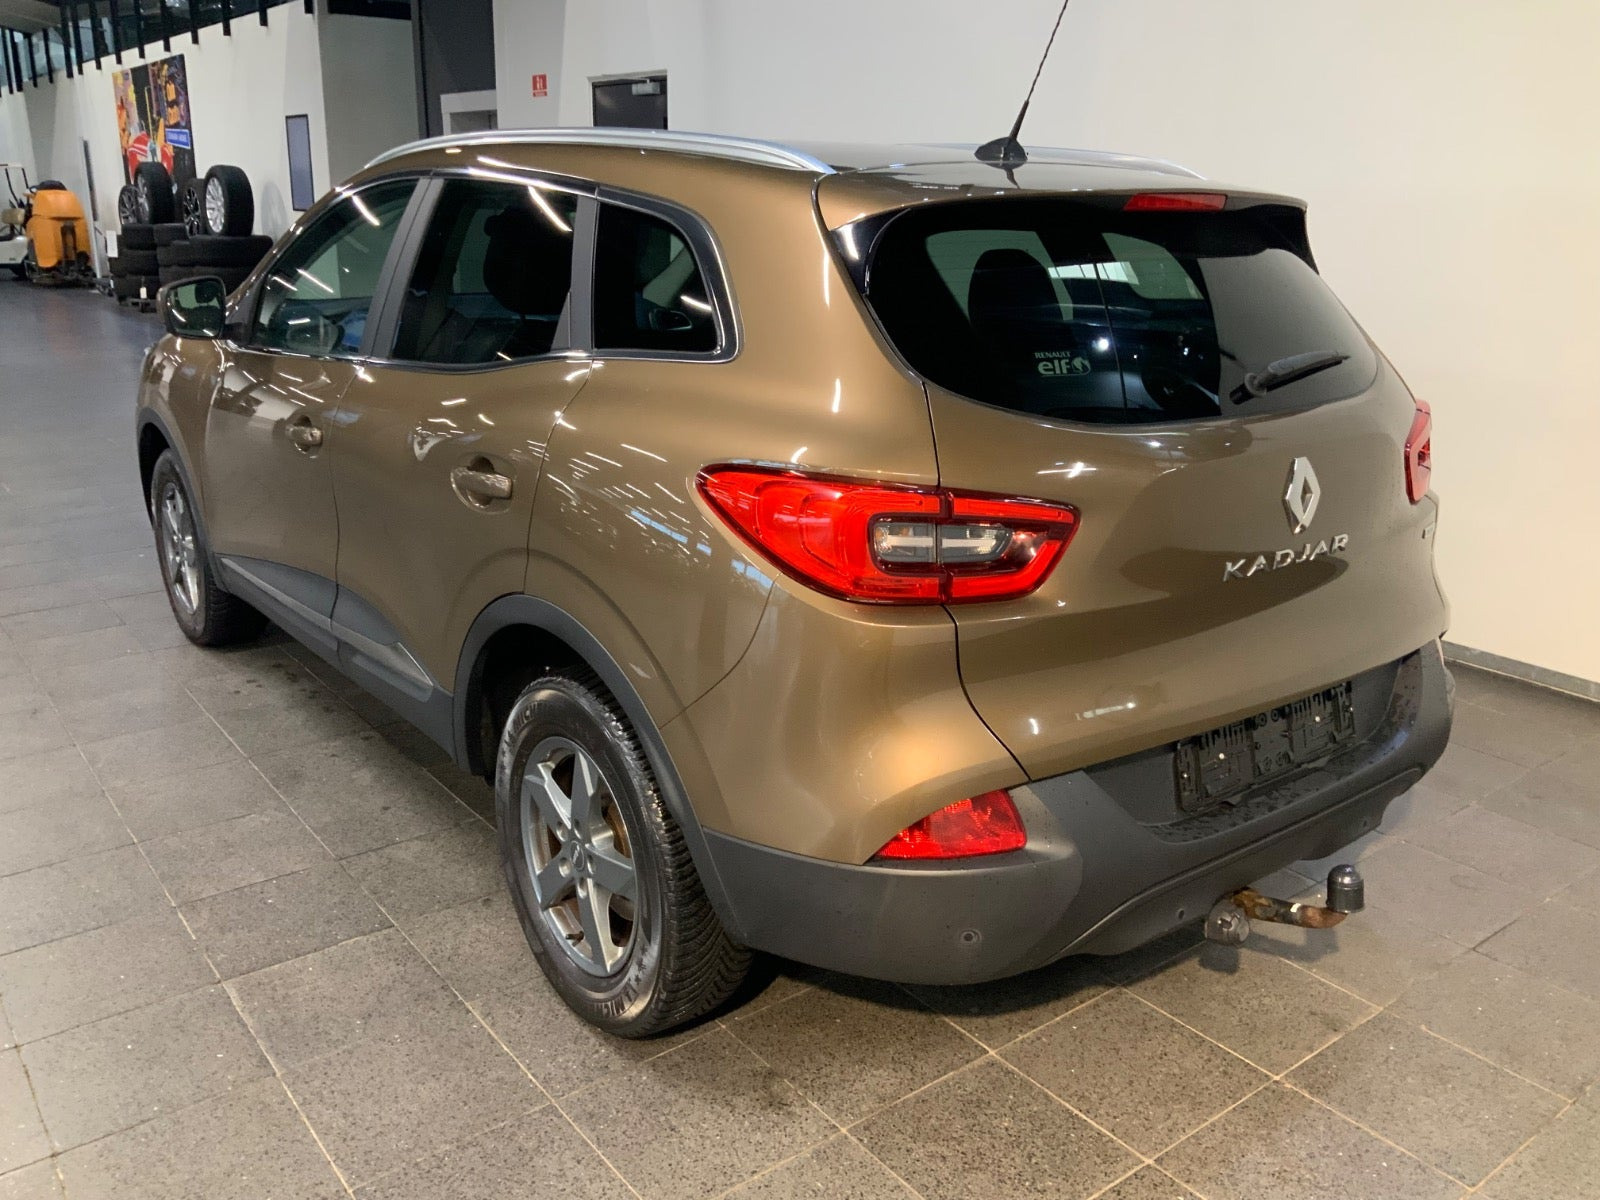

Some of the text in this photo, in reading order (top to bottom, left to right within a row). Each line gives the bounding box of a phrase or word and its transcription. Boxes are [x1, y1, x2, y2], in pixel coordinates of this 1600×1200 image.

[1034, 351, 1071, 359] RENAULT
[1037, 359, 1071, 375] elf
[1223, 534, 1349, 582] KADJAR
